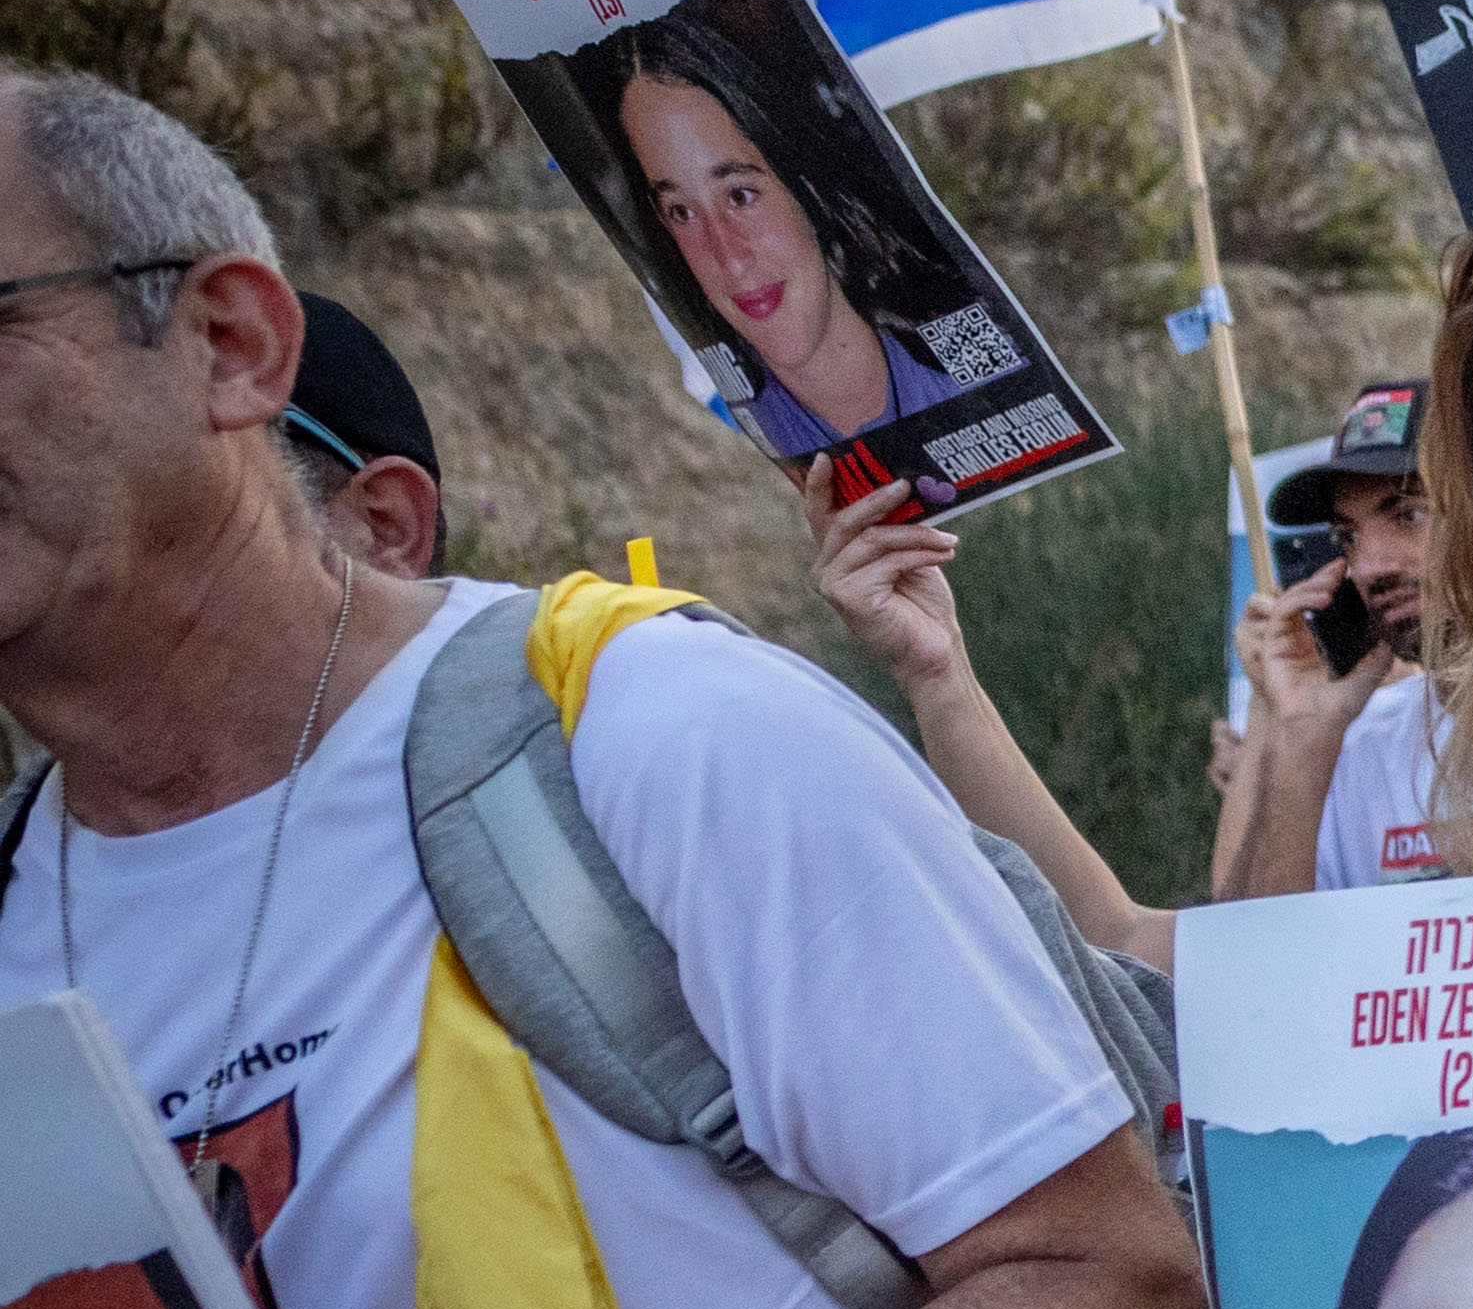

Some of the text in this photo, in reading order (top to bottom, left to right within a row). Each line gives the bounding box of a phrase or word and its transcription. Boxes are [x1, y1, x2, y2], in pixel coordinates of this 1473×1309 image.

[922, 392, 1064, 461] HOSTAGES MISSING
[936, 434, 1024, 483] FAMILIES
[1012, 409, 1083, 454] FORUM
[1351, 986, 1430, 1049] EDEN
